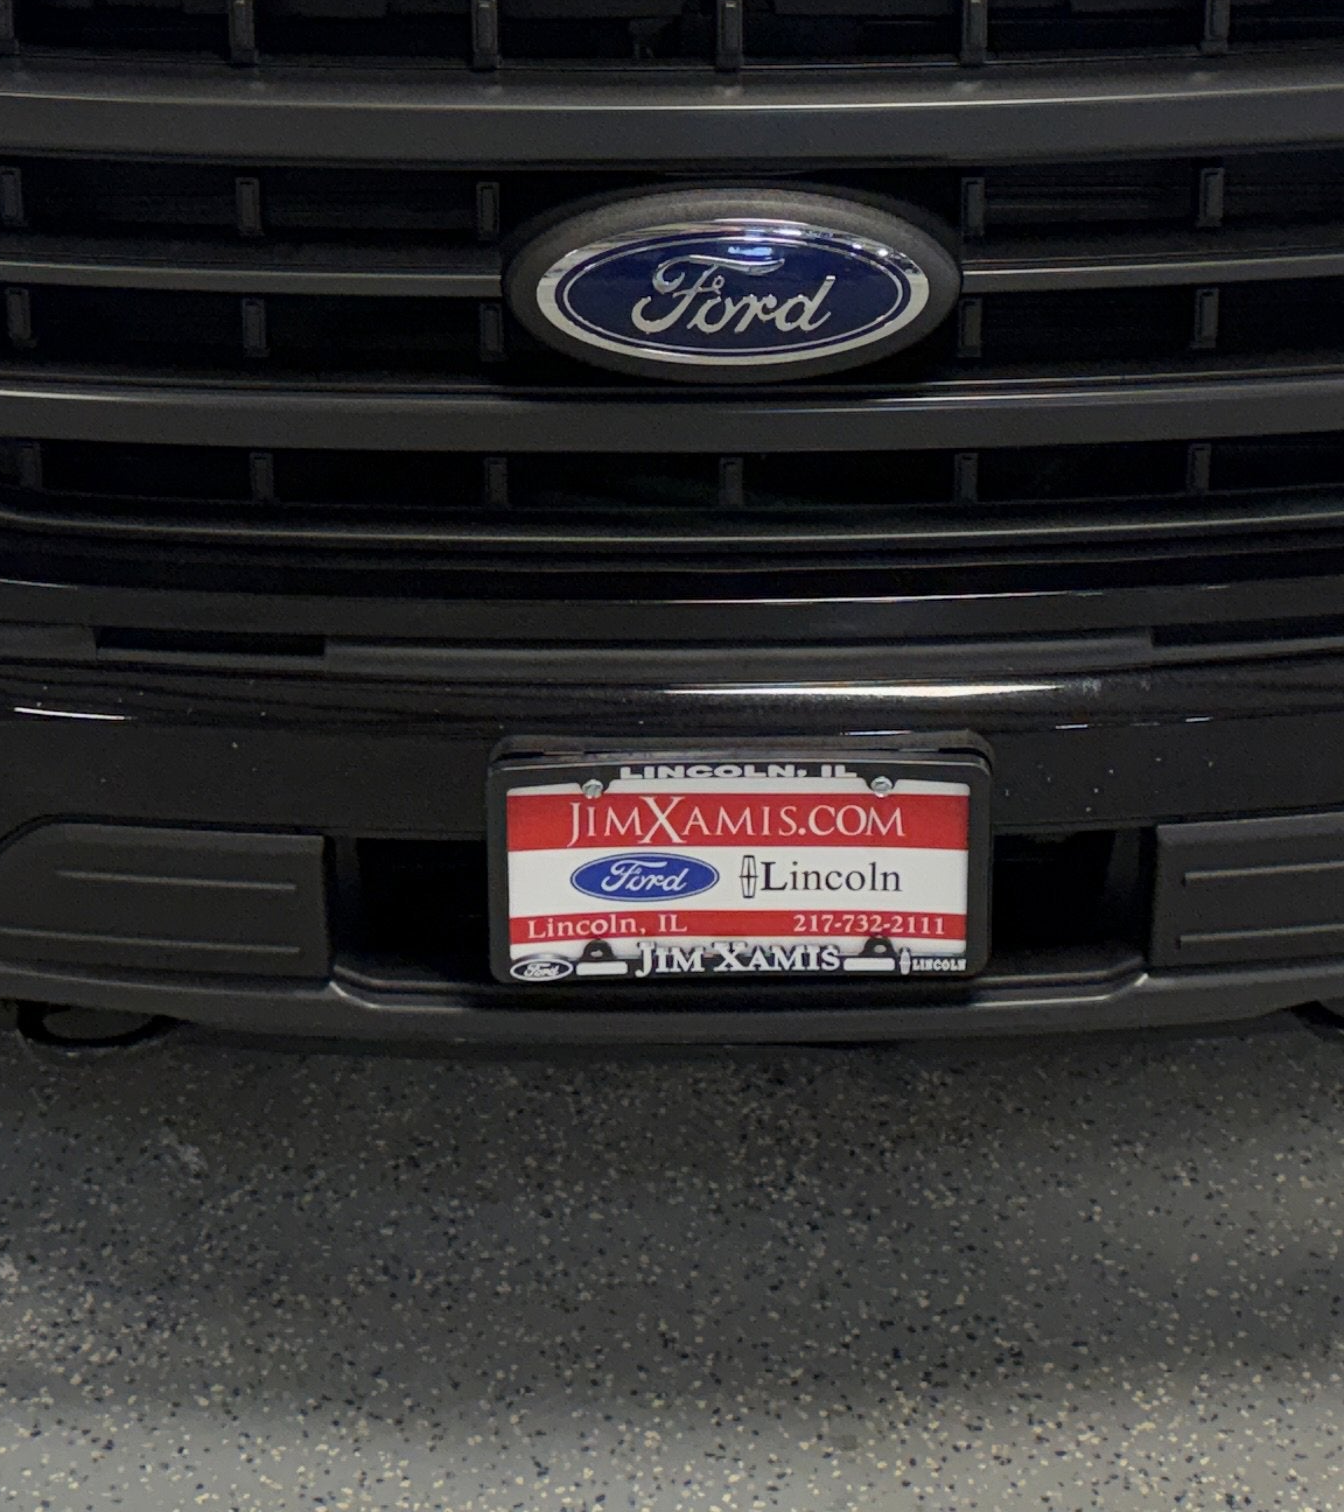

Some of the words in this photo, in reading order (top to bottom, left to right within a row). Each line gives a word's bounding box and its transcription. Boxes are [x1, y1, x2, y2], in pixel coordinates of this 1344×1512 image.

[630, 253, 837, 334] Ford
[619, 765, 808, 780] LINCOLN,
[820, 764, 858, 779] IL
[567, 796, 907, 848] JIMXAMIS.COM
[600, 859, 688, 894] Ford
[760, 861, 904, 892] Lincoln
[527, 915, 646, 940] Lincoln,
[658, 915, 688, 934] IL
[793, 915, 946, 936] 217-732-2111
[523, 962, 560, 978] Ford
[635, 941, 706, 978] JIM
[712, 942, 841, 973] XAMIS
[912, 958, 967, 972] LINCOLN
